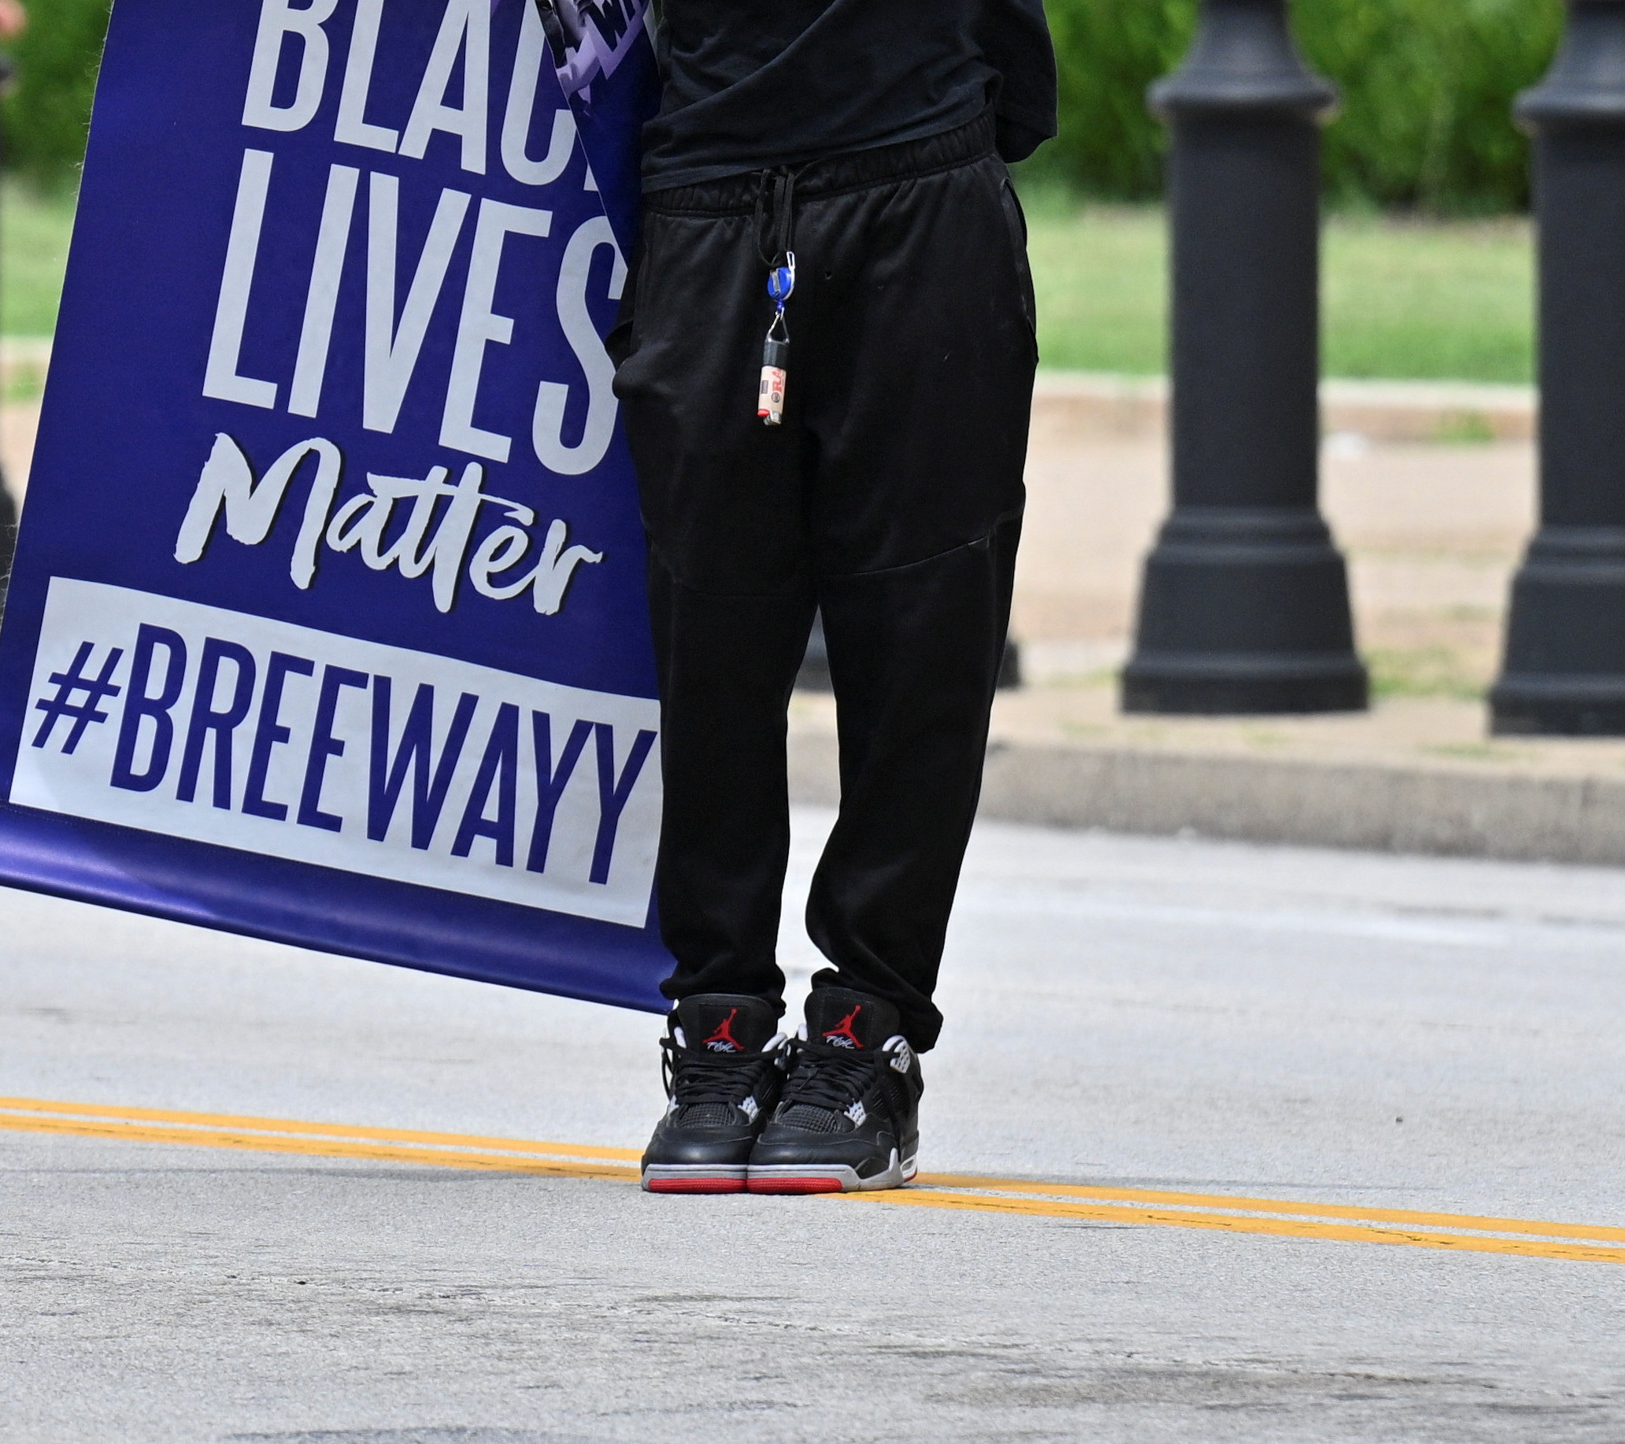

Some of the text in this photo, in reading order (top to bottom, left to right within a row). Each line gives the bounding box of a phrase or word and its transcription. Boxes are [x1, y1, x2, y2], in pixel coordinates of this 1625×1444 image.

[203, 150, 627, 476] LIVES
[174, 432, 604, 615] Matter
[32, 622, 657, 885] #BREEWAYY
